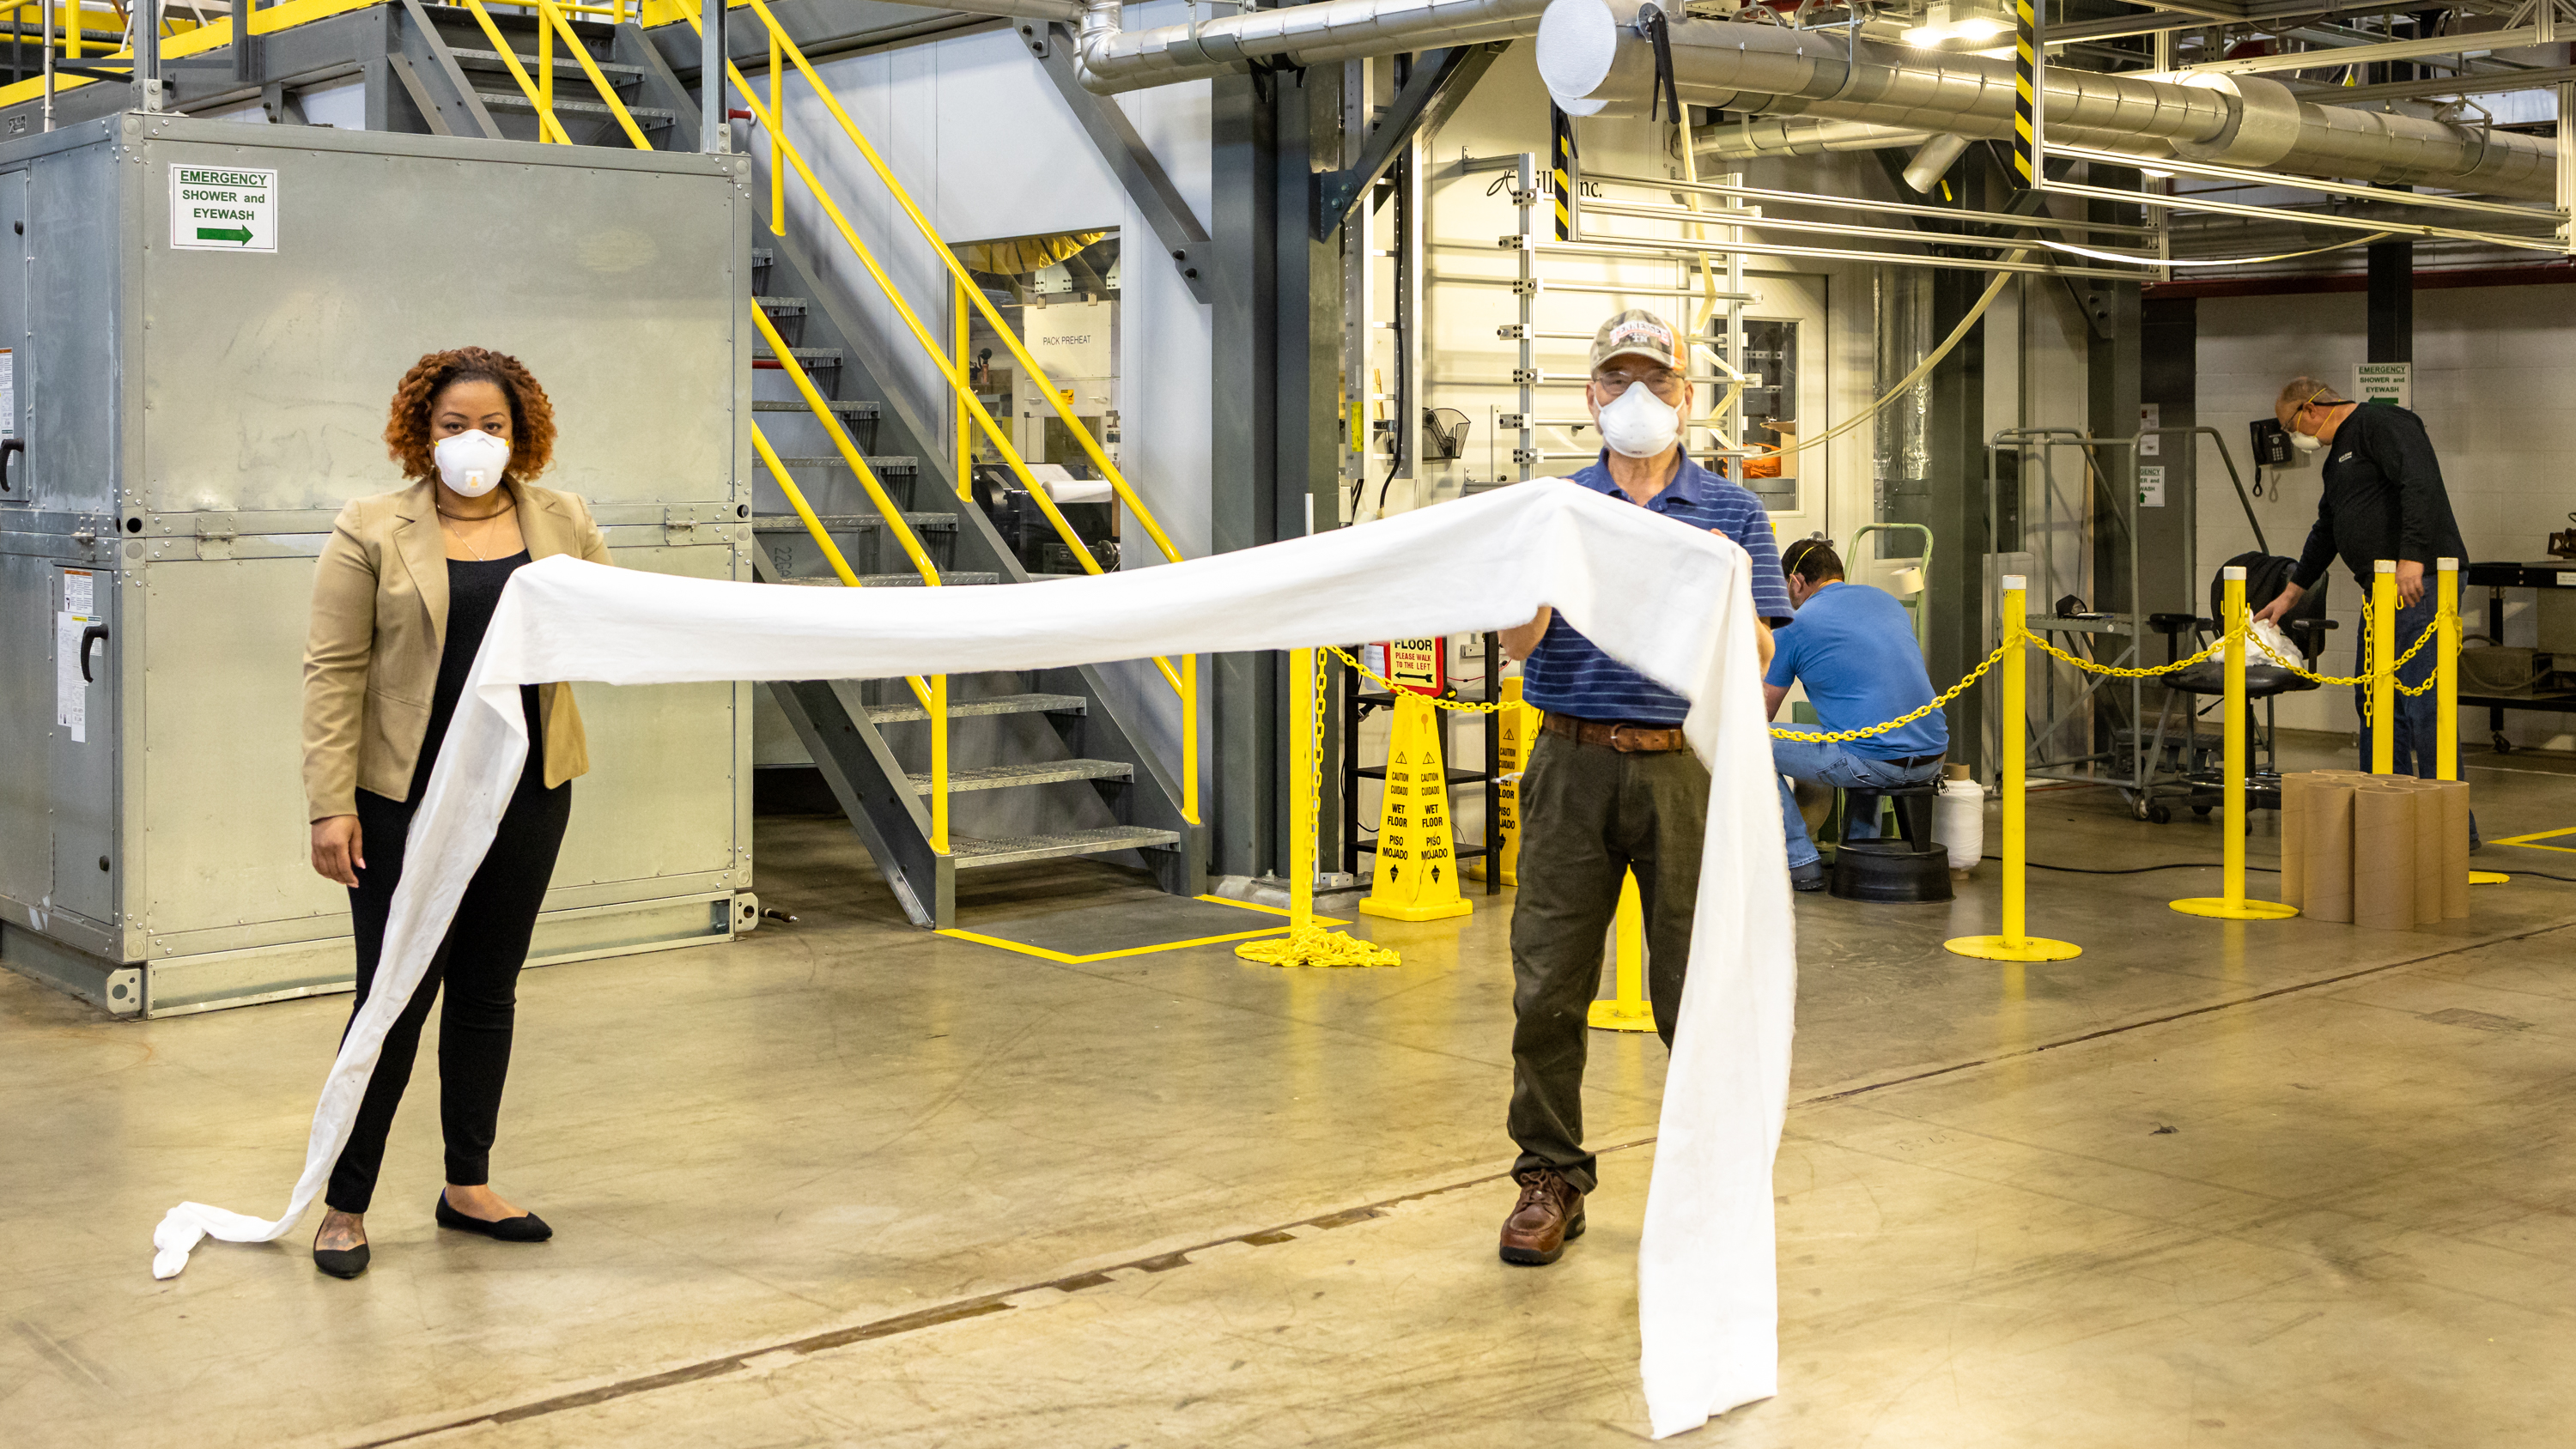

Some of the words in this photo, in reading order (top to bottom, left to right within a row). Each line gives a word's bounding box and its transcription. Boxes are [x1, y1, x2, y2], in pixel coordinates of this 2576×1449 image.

[180, 170, 267, 185] EMERGENCY
[1579, 180, 1602, 198] nc.
[182, 190, 238, 202] SHOWER
[244, 194, 265, 203] and
[193, 208, 254, 221] EYEWASH
[1609, 320, 1670, 346] TENNESSEE
[1042, 336, 1060, 345] PACK
[1061, 335, 1091, 345] PREHEAT
[1394, 639, 1432, 651] FLOOR
[1416, 653, 1431, 662] WALK
[1500, 747, 1516, 757] CAUTION
[1498, 760, 1515, 770] CUIDADO
[1392, 772, 1409, 782] CAUTION
[1421, 773, 1438, 782] CAUTION
[1390, 785, 1408, 796] CUIDADO
[1421, 785, 1440, 796] CUIDADO
[1498, 789, 1515, 799] LOOR
[1392, 803, 1405, 814] WET
[1425, 804, 1438, 815] WET
[1388, 815, 1407, 828] FLOOR
[1422, 817, 1443, 828] FLOOR
[1499, 819, 1516, 829] JADO
[1389, 835, 1403, 846] PISO
[1426, 836, 1441, 846] PISO
[1382, 847, 1408, 860] MOJADO
[1421, 848, 1448, 860] MOJADO
